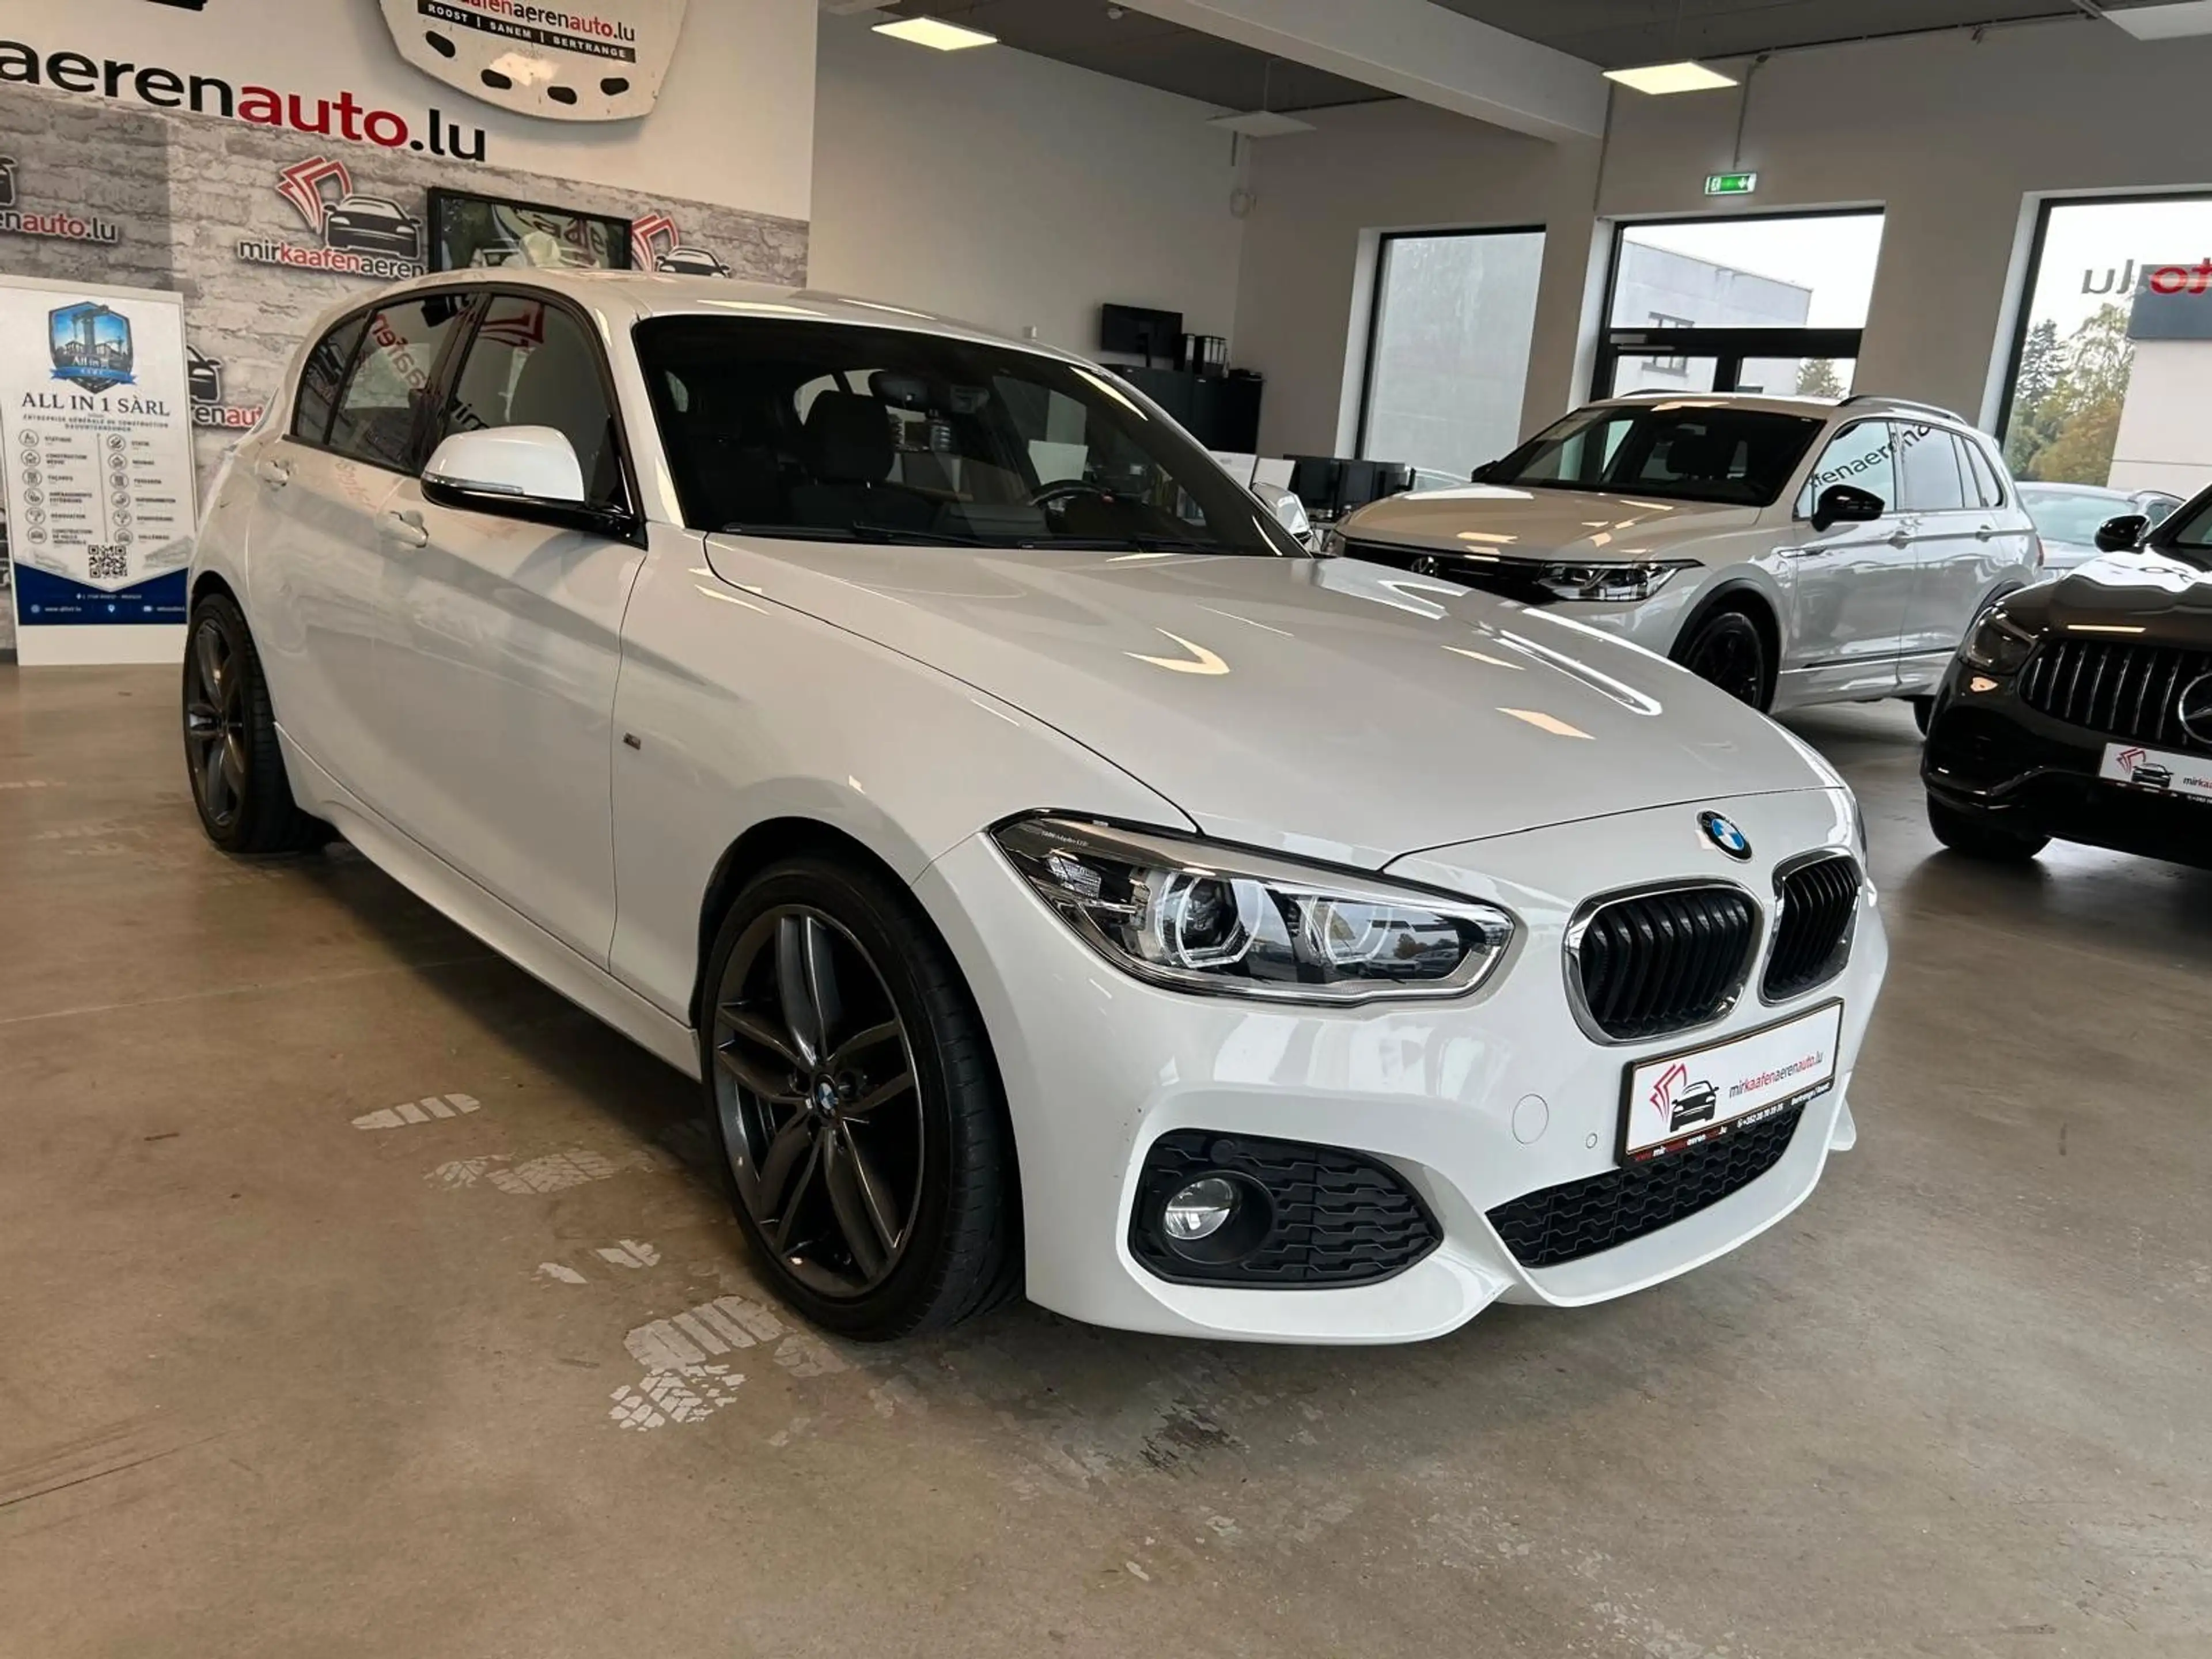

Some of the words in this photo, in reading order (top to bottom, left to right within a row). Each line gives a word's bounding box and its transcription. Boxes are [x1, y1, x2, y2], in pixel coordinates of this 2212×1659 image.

[428, 3, 468, 22] ROOST
[490, 22, 531, 39] SANEM
[553, 35, 626, 58] BERTRANGE
[0, 212, 115, 240] nauto.lu
[240, 240, 431, 278] mirkaafenaeren
[22, 392, 64, 409] ALL
[71, 395, 93, 410] IN
[101, 397, 110, 412] 1
[117, 395, 171, 416] SÀRL
[191, 406, 264, 425] enau
[1729, 1050, 1824, 1099] mirkaafenaerenauto.lu
